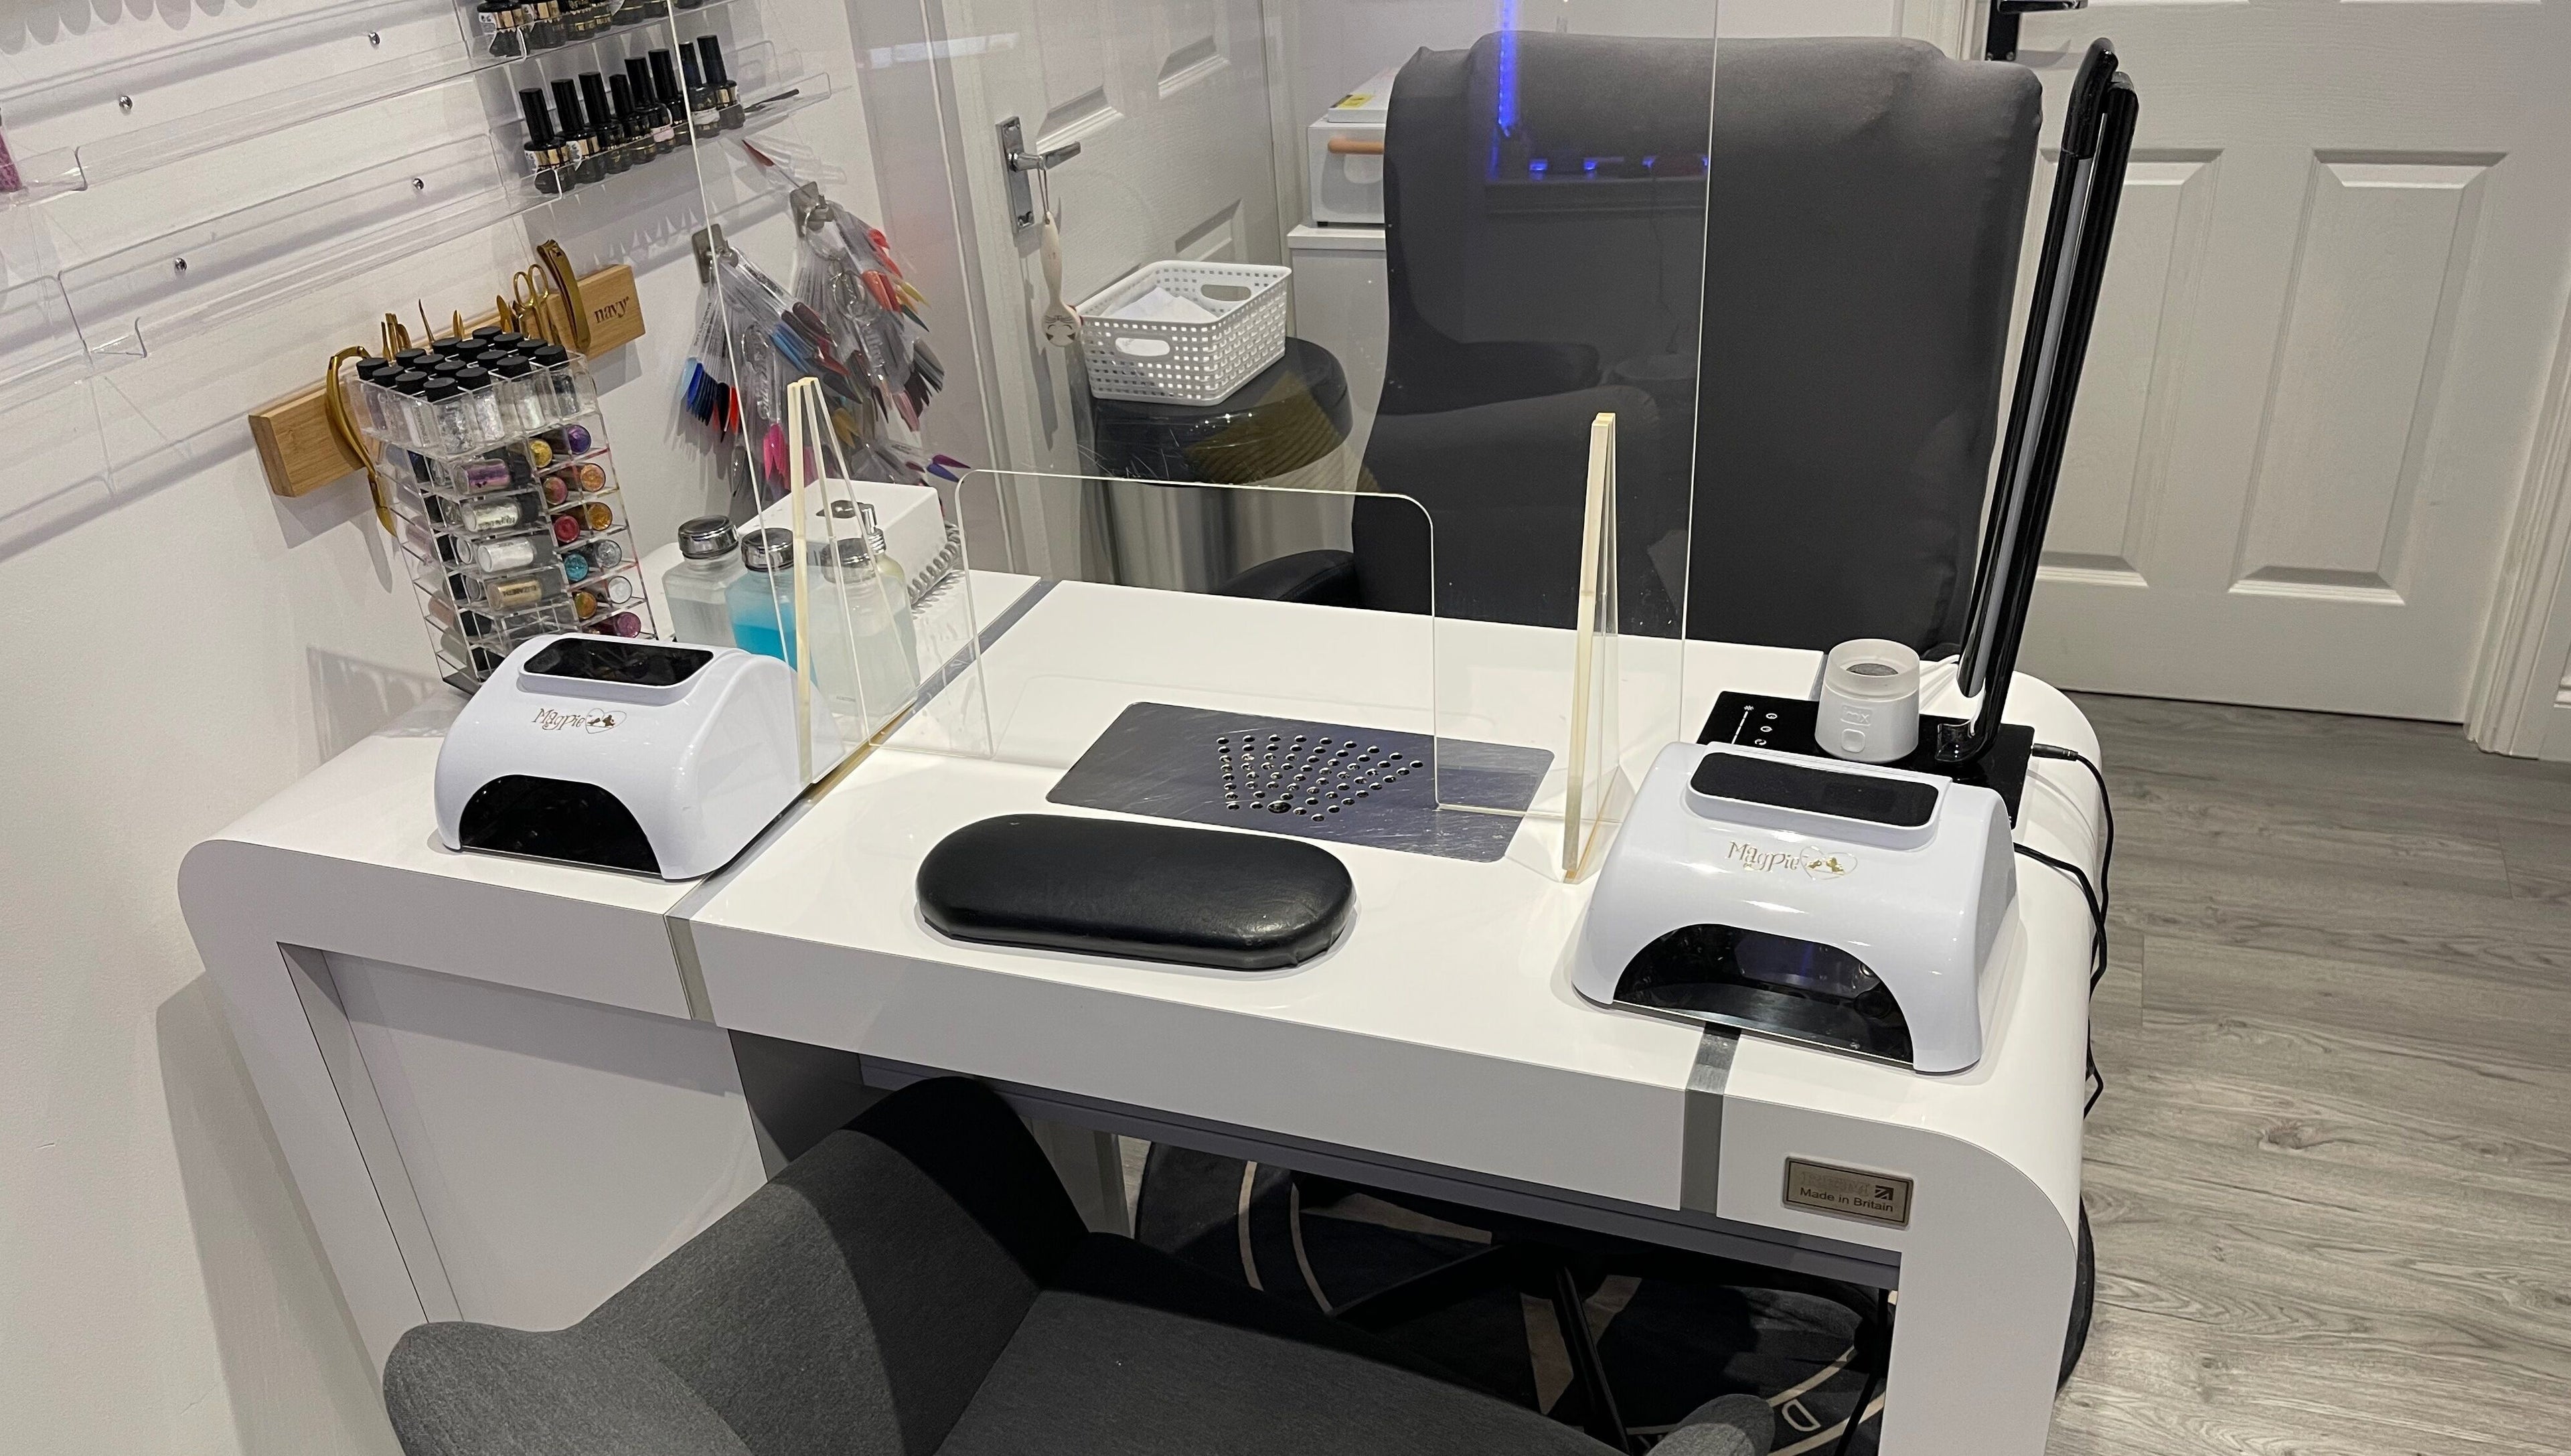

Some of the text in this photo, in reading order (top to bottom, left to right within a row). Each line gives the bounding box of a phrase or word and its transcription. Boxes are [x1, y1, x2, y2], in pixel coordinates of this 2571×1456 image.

[594, 296, 629, 323] navy
[531, 708, 586, 731] Magpie
[1725, 839, 1800, 873] Magpie
[1800, 1187, 1893, 1212] Made in Britain
